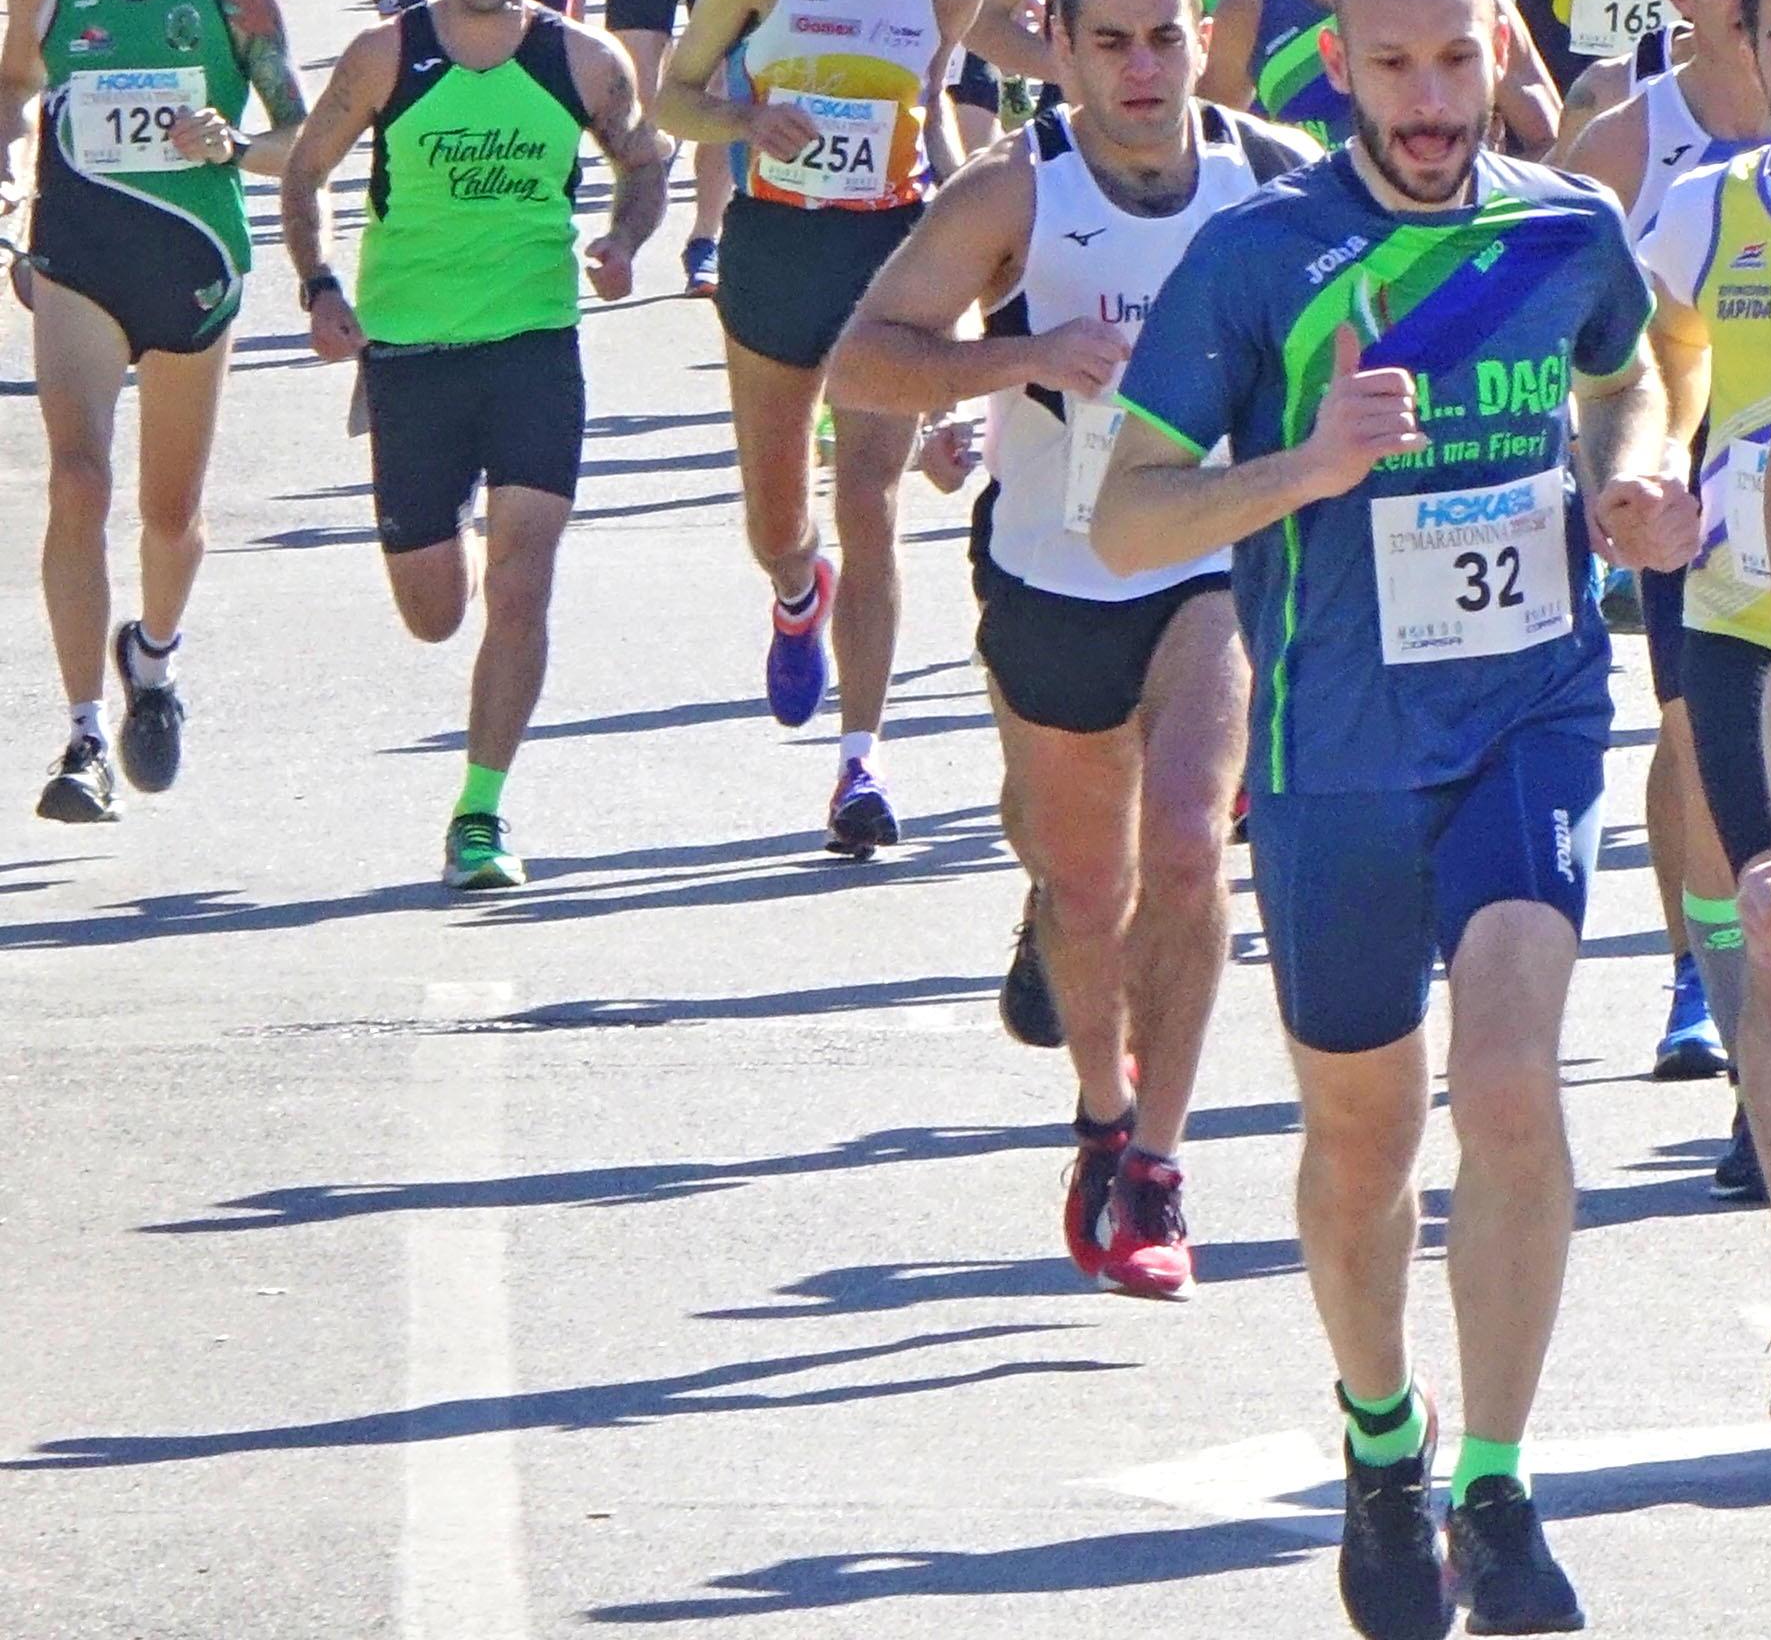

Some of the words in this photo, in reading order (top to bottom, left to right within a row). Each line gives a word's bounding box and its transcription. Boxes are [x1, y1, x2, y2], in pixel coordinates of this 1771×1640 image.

[1604, 1, 1662, 34] 165
[105, 106, 178, 145] 129
[418, 127, 548, 167] Triathlon
[786, 135, 875, 173] 25A
[448, 166, 549, 202] Calling
[1100, 293, 1151, 324] Uni
[1444, 437, 1480, 467] ma
[1489, 429, 1547, 461] Fieri
[1416, 491, 1505, 530] HOKA
[1453, 545, 1525, 613] 32
